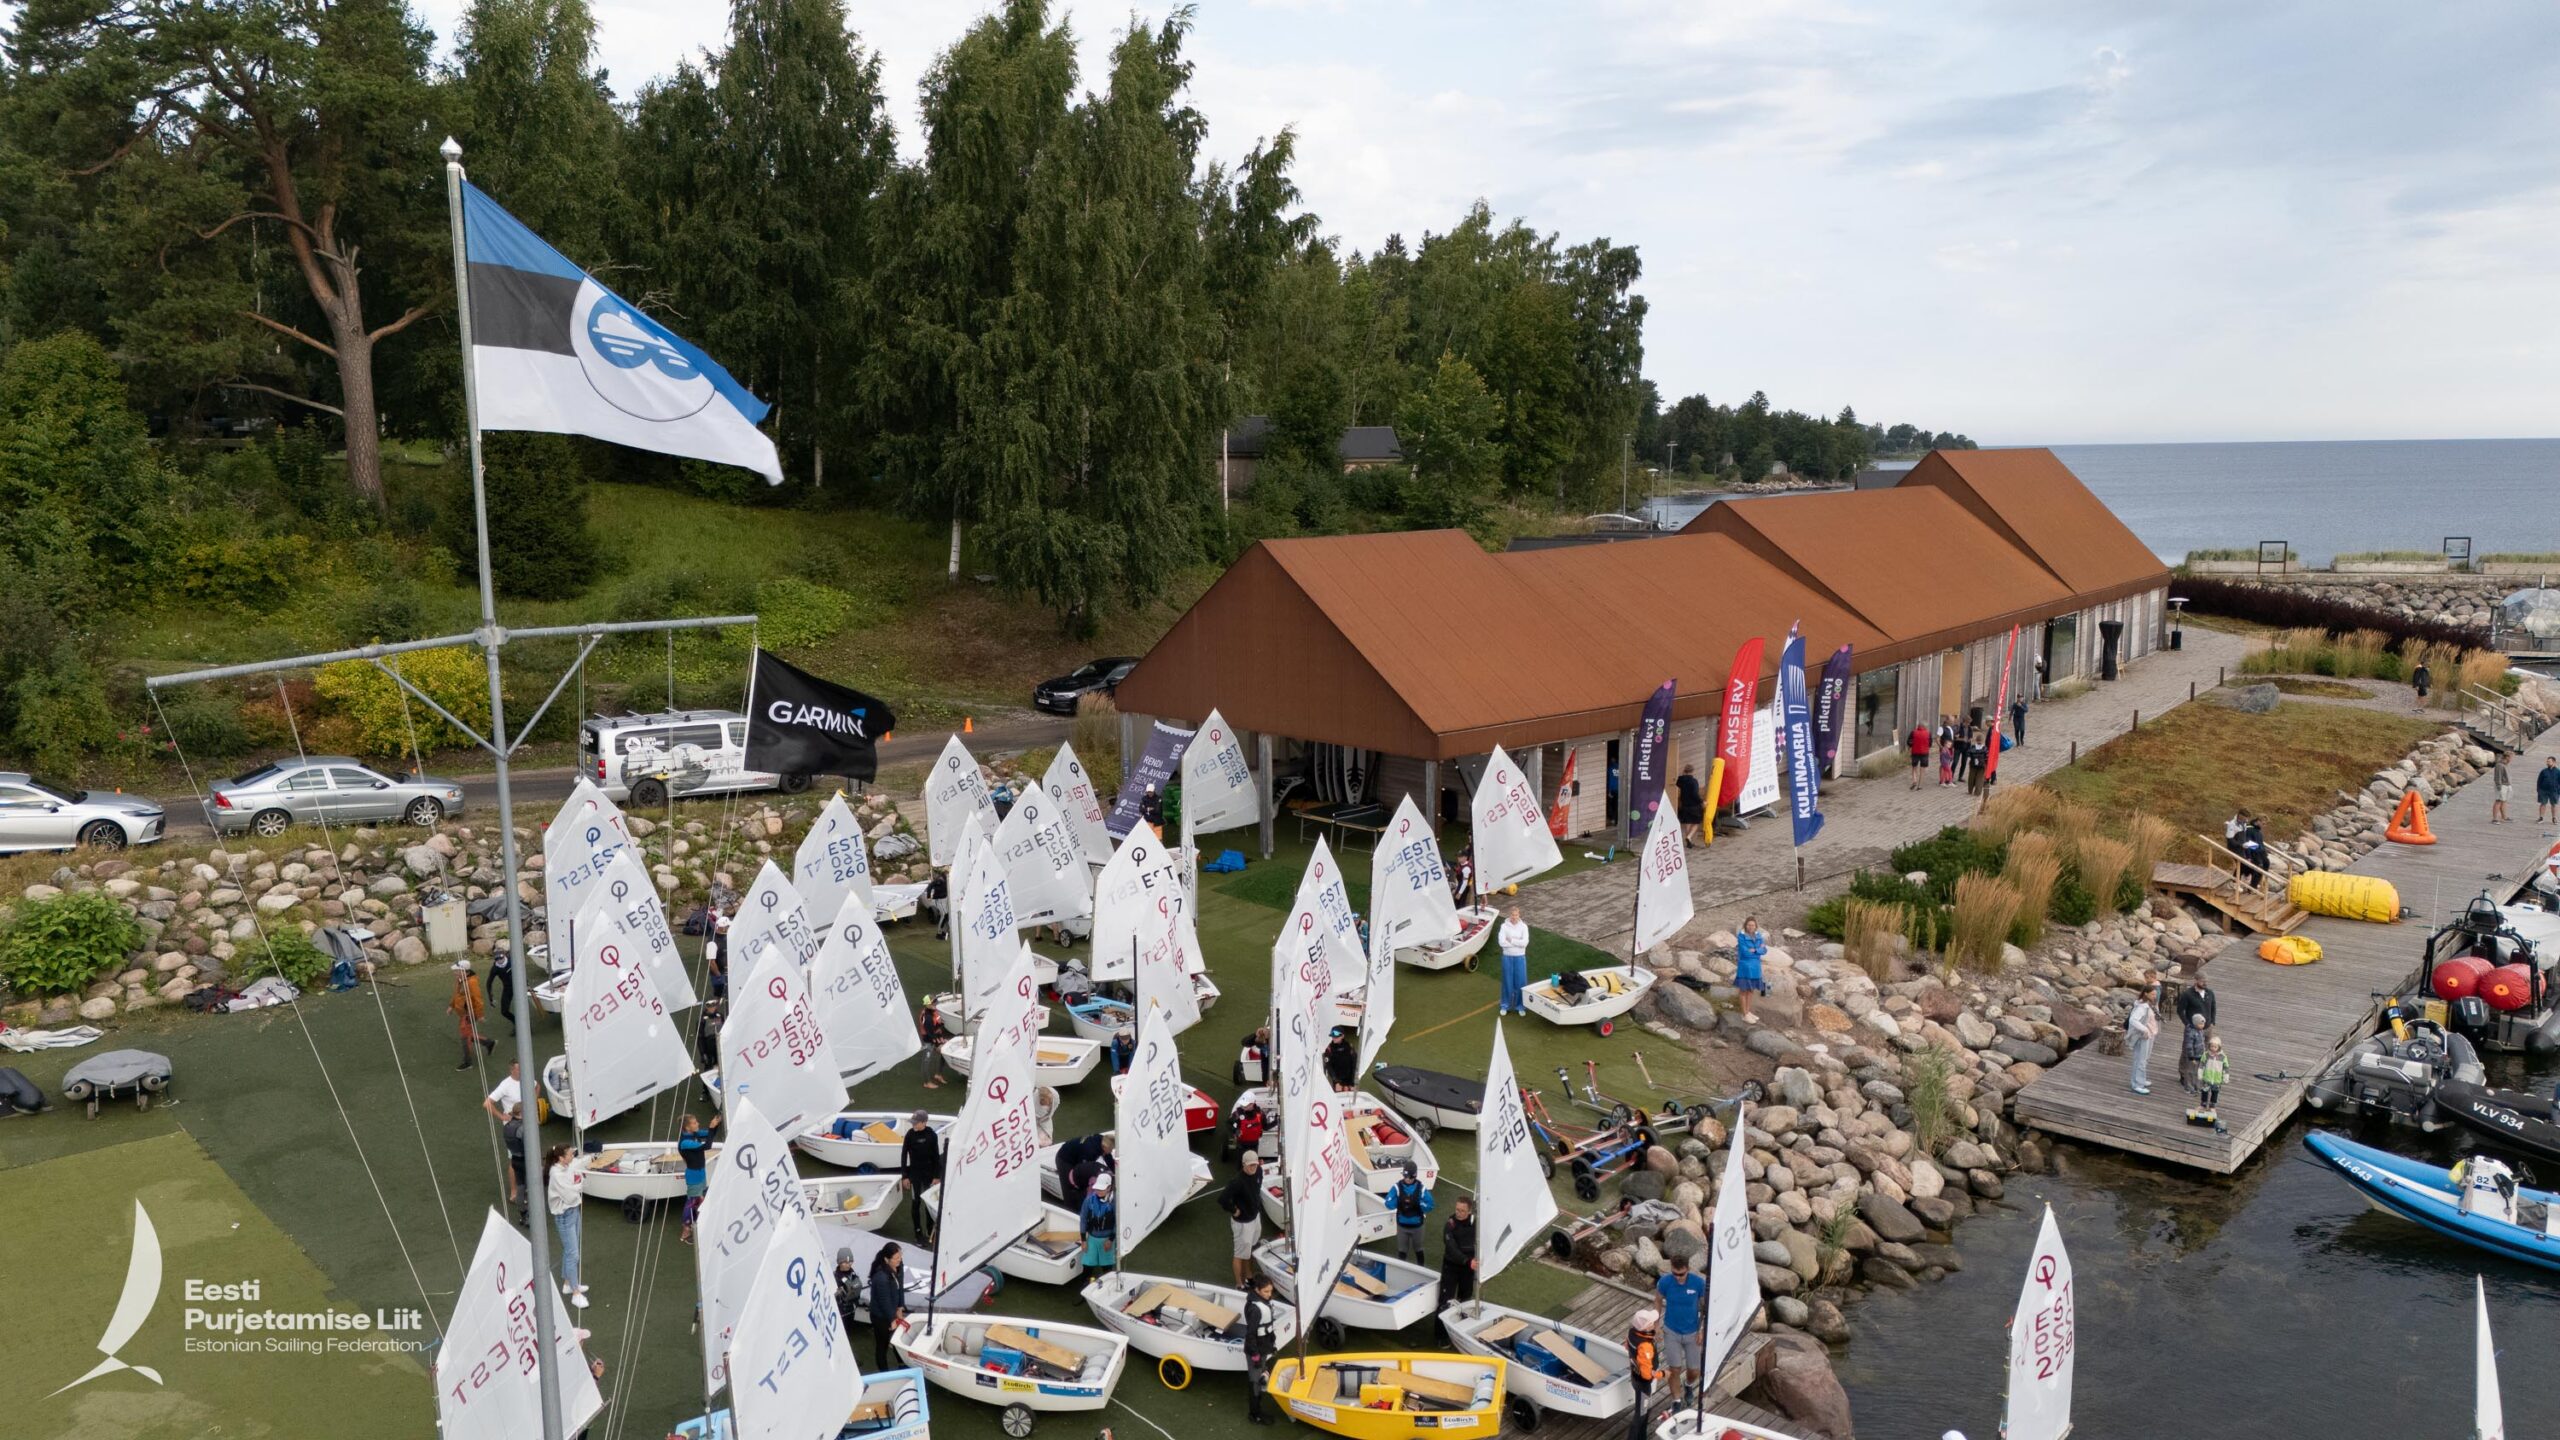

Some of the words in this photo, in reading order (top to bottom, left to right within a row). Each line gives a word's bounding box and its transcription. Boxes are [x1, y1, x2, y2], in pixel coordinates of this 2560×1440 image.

[1726, 679, 1745, 757] AMSERV
[1819, 677, 1834, 732] piletilevi
[768, 701, 867, 739] GARMIN
[1218, 744, 1239, 765] EST
[1638, 718, 1655, 780] piletilevi
[958, 770, 979, 791] EST
[1228, 766, 1249, 788] 285
[1791, 722, 1810, 818] KULINAARIA
[1073, 784, 1089, 799] EST
[1084, 808, 1102, 823] 410
[1523, 806, 1541, 827] 191
[828, 834, 860, 855] EST
[1034, 822, 1061, 847] EST
[1403, 837, 1432, 862] EST
[834, 862, 866, 882] 260
[1052, 851, 1074, 871] 331
[1658, 856, 1683, 883] 250
[1410, 866, 1443, 890] 275
[1319, 881, 1341, 909] EST
[626, 897, 655, 929] EST
[776, 906, 806, 939] EST
[987, 911, 1013, 940] 328
[651, 930, 670, 953] 98
[1308, 934, 1326, 965] EST
[862, 939, 888, 975] EST
[617, 962, 645, 1000] EST
[877, 974, 900, 1008] 326
[782, 992, 808, 1033] EST
[1340, 1010, 1358, 1018] Audi
[790, 1027, 823, 1066] 335
[1150, 1059, 1176, 1102] EST
[992, 1096, 1028, 1140] EST
[2473, 1102, 2499, 1118] VLV
[2500, 1114, 2525, 1131] 934
[1503, 1119, 1526, 1154] 419
[995, 1143, 1034, 1178] 235
[2476, 1175, 2490, 1185] 82
[2035, 1280, 2070, 1332] EST
[2036, 1331, 2074, 1380] 229
